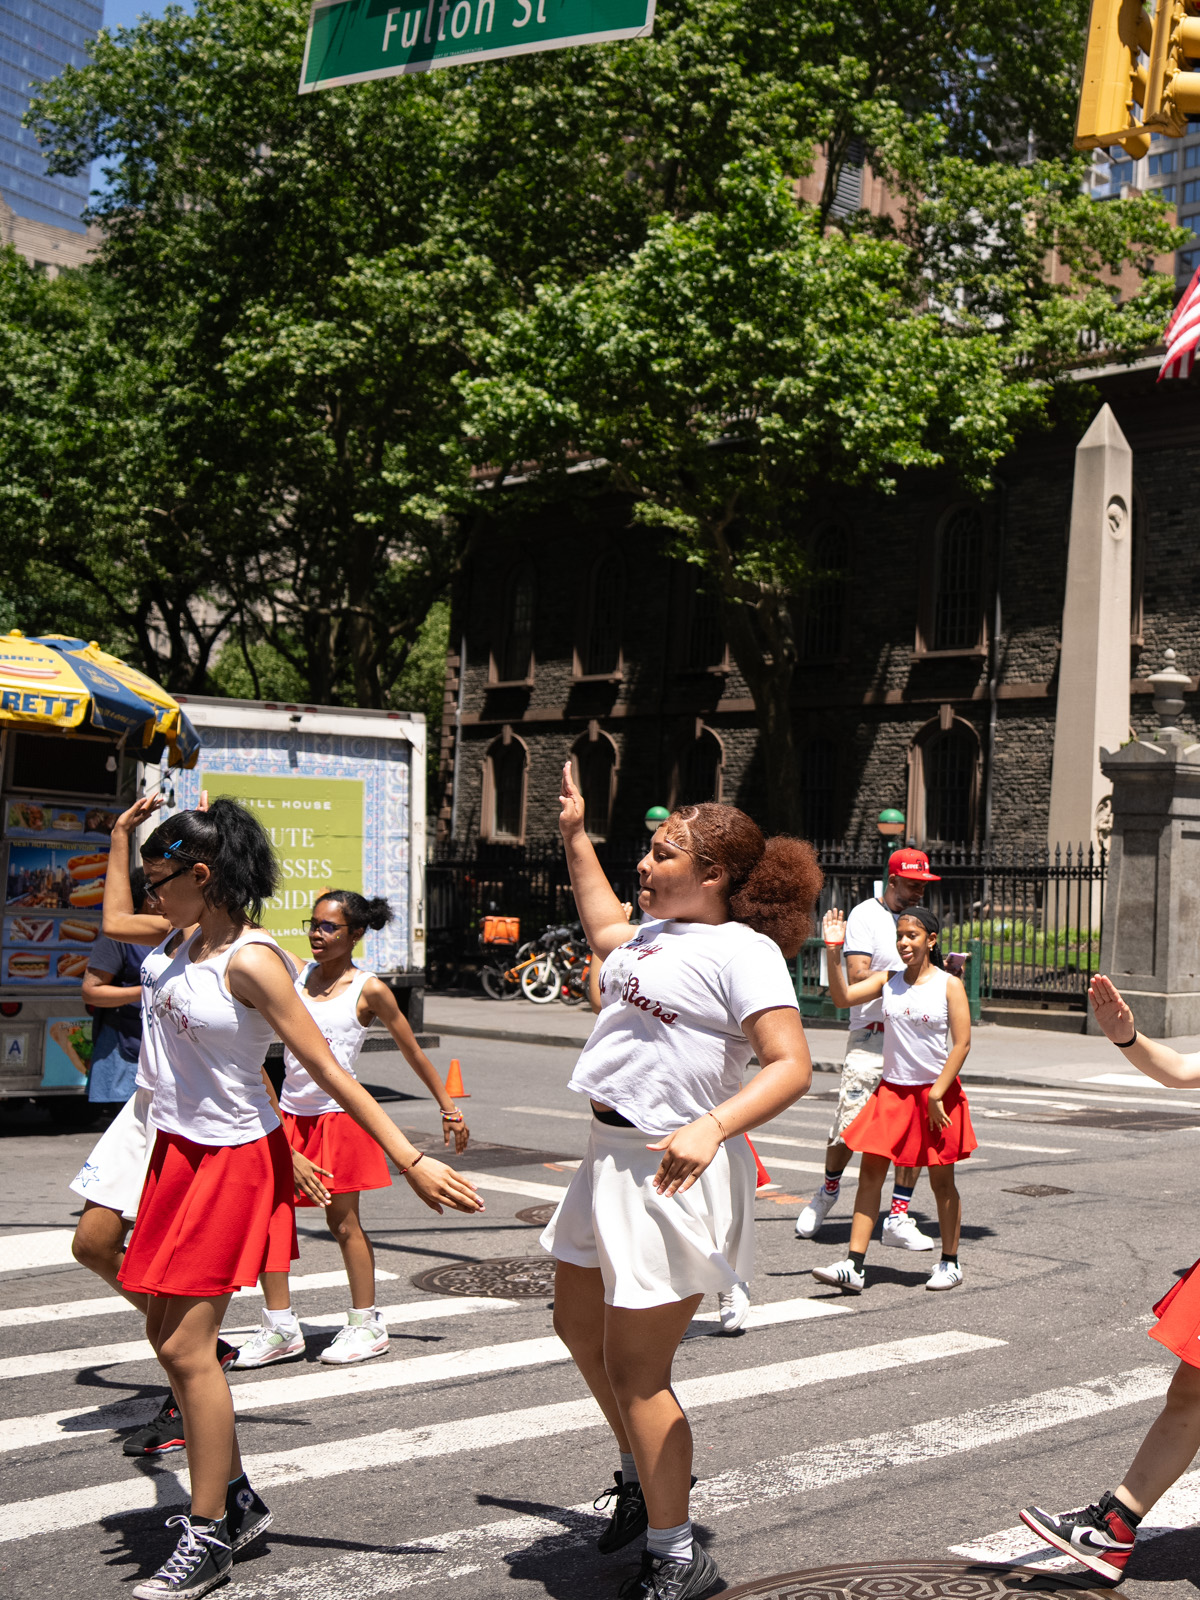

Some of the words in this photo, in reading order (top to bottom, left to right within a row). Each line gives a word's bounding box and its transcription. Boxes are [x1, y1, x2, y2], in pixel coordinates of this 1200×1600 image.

[381, 0, 495, 52] Fulton
[282, 800, 332, 811] HOUSE
[268, 827, 315, 849] UTE
[281, 858, 333, 880] SSES
[622, 973, 679, 1025] Stars
[8, 1039, 21, 1056] A
